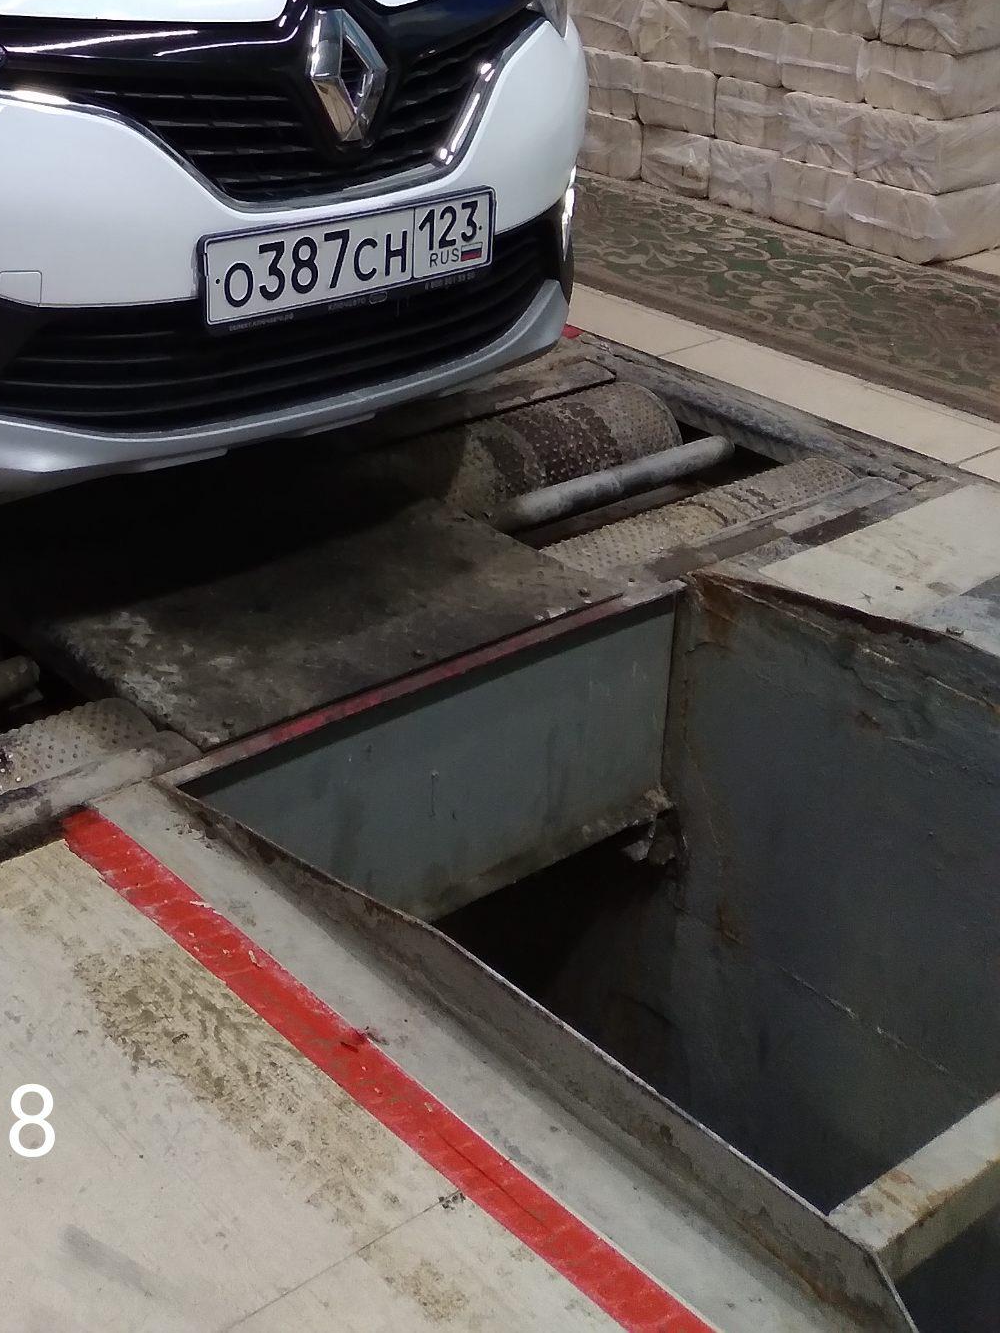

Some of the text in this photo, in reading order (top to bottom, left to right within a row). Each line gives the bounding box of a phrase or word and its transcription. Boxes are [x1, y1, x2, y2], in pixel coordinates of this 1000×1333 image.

[223, 201, 479, 308] О387СН 123
[429, 248, 460, 268] RUS
